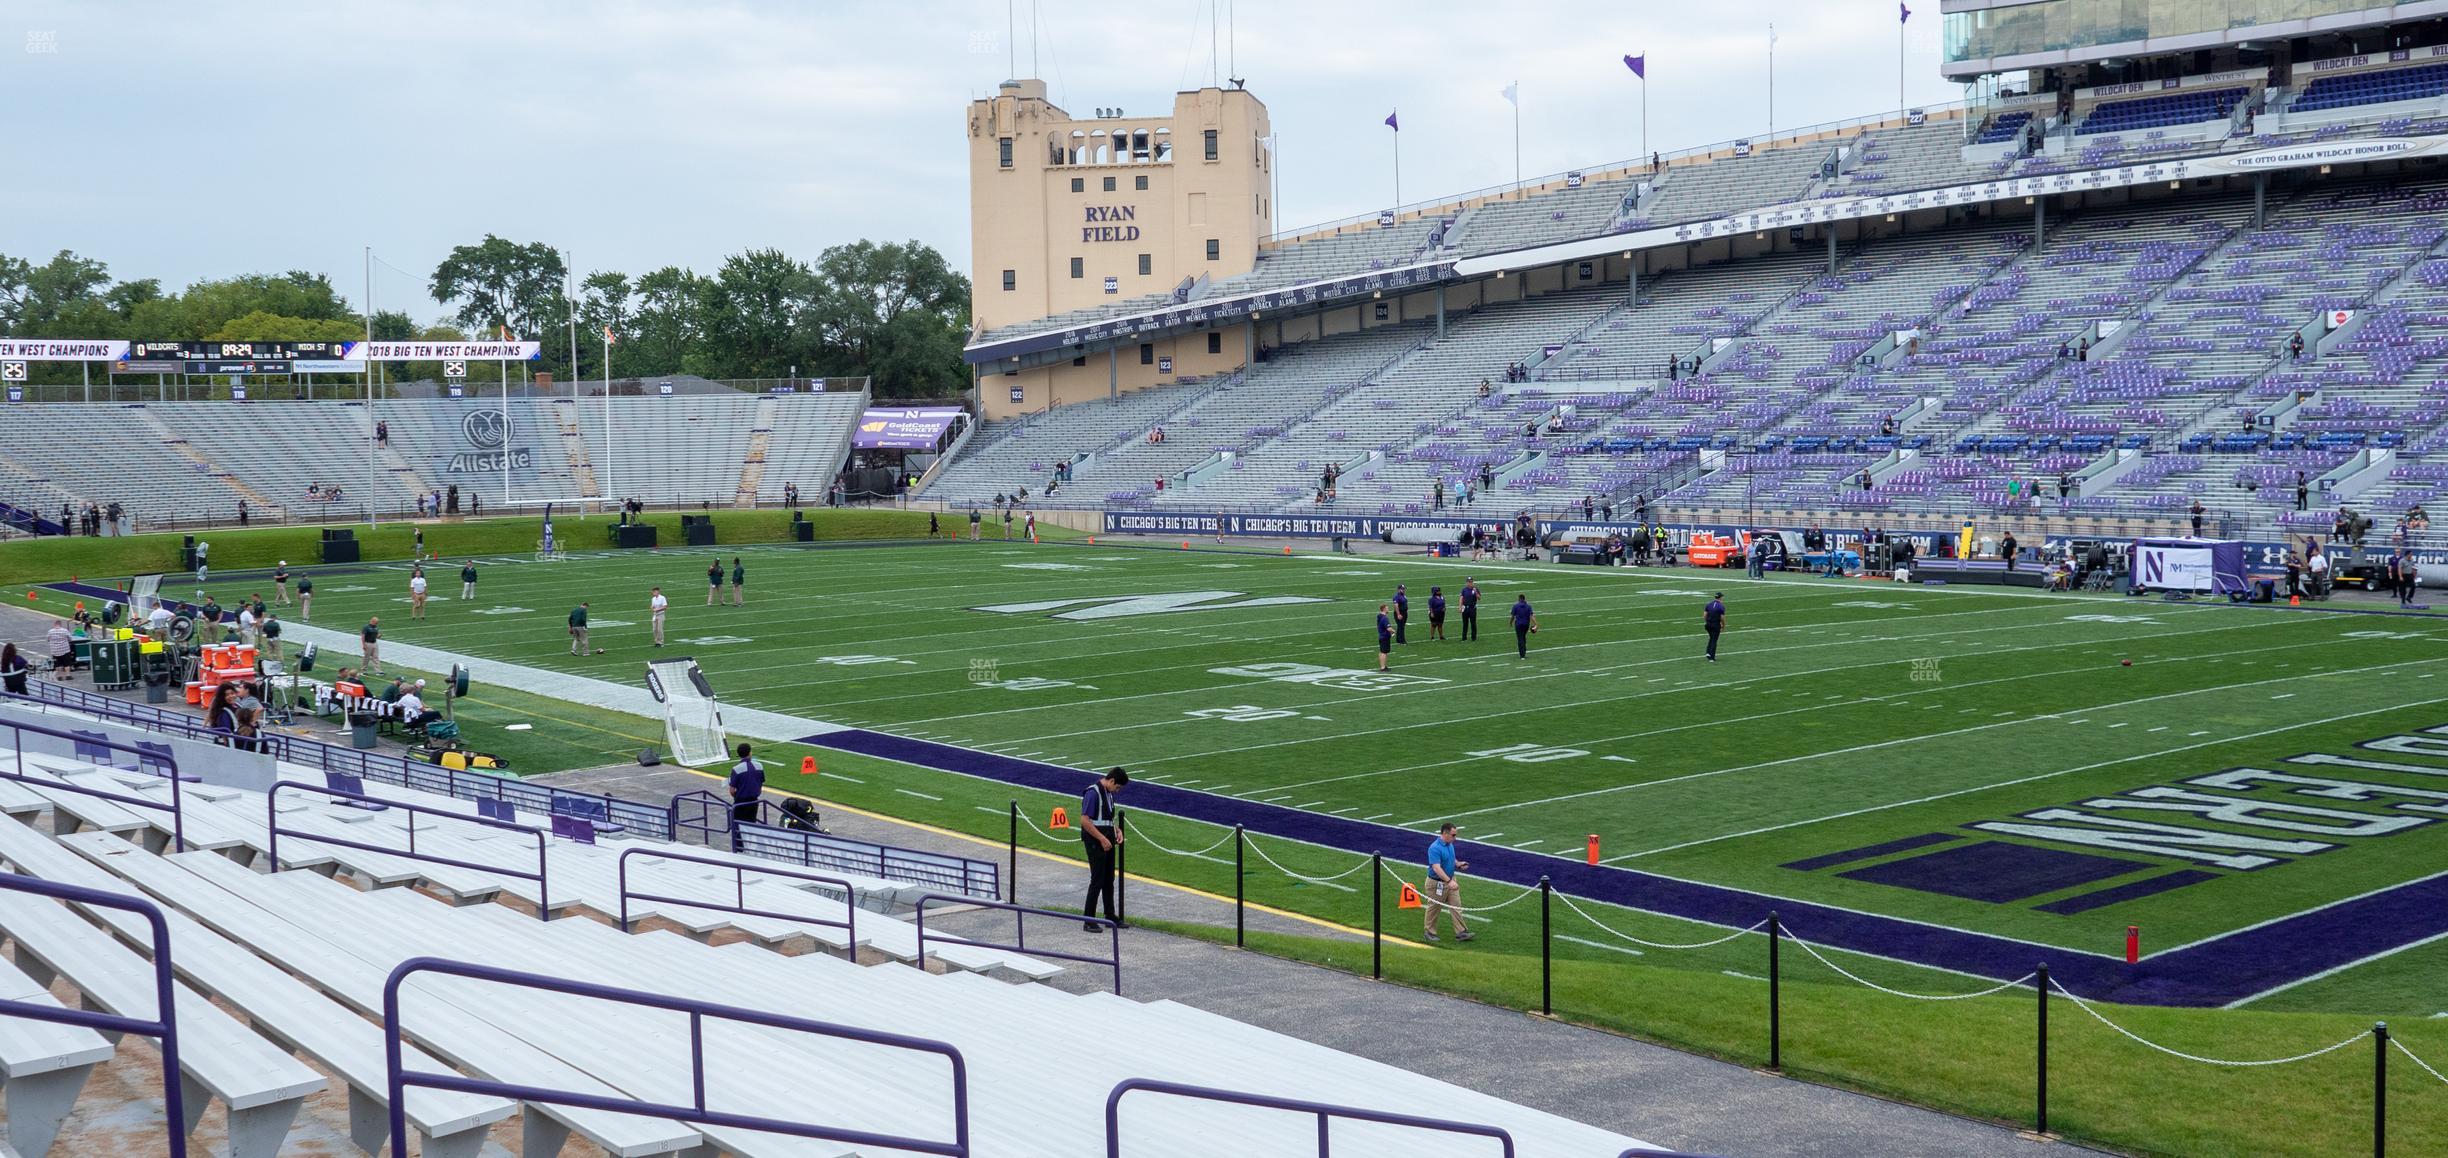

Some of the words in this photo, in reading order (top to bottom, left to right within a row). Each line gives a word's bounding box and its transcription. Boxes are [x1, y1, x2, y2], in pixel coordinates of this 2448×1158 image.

[2313, 57, 2351, 71] WILDCAT
[2352, 55, 2369, 66] DEN
[2205, 71, 2248, 82] WINTRUST
[2093, 84, 2128, 97] WILDCAT
[2128, 83, 2144, 92] DEN
[1910, 114, 1923, 123] 227
[2237, 158, 2254, 166] THE
[2255, 156, 2277, 164] OTTO
[2278, 153, 2314, 161] GRAHAM
[2317, 149, 2353, 158] WILDCAT
[2355, 145, 2384, 154] HONOR
[1568, 177, 1581, 185] 225
[1085, 205, 1136, 222] RYAN
[1382, 215, 1394, 224] 224
[1082, 225, 1140, 243] FIELD
[1390, 277, 1410, 287] CITRUS
[1416, 274, 1430, 282] ROSE
[1105, 281, 1117, 290] 223
[1364, 281, 1384, 290] ALAMO
[1323, 289, 1341, 298] MOTOR
[1345, 286, 1358, 294] CITY
[1279, 297, 1298, 307] ALAMO
[1305, 294, 1317, 302] SUN
[1248, 301, 1273, 312] OUTBACK
[1186, 313, 1208, 322] MEINEKE
[1214, 307, 1242, 318] TICKETCITY
[1139, 322, 1160, 331] OUTBACK
[1165, 318, 1181, 327] GATOR
[0, 344, 14, 356] EN
[19, 344, 46, 356] WEST
[50, 344, 109, 357] CHAMPIONS
[137, 344, 146, 357] 0
[146, 343, 179, 351] WILDCATS
[221, 344, 252, 356] 89:29
[298, 343, 315, 351] MICH
[317, 343, 326, 351] ST
[334, 344, 342, 357] 0
[367, 345, 391, 357] 2018
[394, 345, 411, 357] BIG
[414, 345, 432, 357] TEN
[435, 345, 460, 357] WEST
[464, 344, 520, 357] CHAMPIONS
[4, 363, 23, 378] 25
[446, 363, 464, 375] 25
[450, 388, 462, 396] 119
[660, 386, 673, 394] 120
[812, 383, 823, 391] 121
[10, 391, 22, 400] 117
[233, 390, 245, 399] 118
[1011, 391, 1022, 399] 122
[905, 410, 919, 418] N
[449, 451, 529, 472] Allstate
[1107, 515, 1115, 529] N
[1121, 516, 1164, 529] CHICAGO'S
[1165, 517, 1180, 530] BIG
[1182, 518, 1199, 530] TEN
[1200, 518, 1225, 530] TEA
[1231, 517, 1239, 532] N
[1245, 518, 1291, 531] CHICAGO'S
[1293, 520, 1308, 533] BIG
[1310, 520, 1329, 533] TEN
[1331, 521, 1356, 533] TEAM
[1363, 520, 1372, 535] N
[1693, 552, 1718, 560] GATORADE
[2146, 551, 2163, 583] N
[648, 672, 664, 700] ROGERS
[1184, 704, 1301, 722] 20
[1463, 743, 1592, 763] 10
[805, 760, 814, 769] 20
[1053, 813, 1066, 826] 10
[1405, 887, 1415, 902] G
[58, 1055, 69, 1068] 21
[472, 1116, 481, 1127] 19
